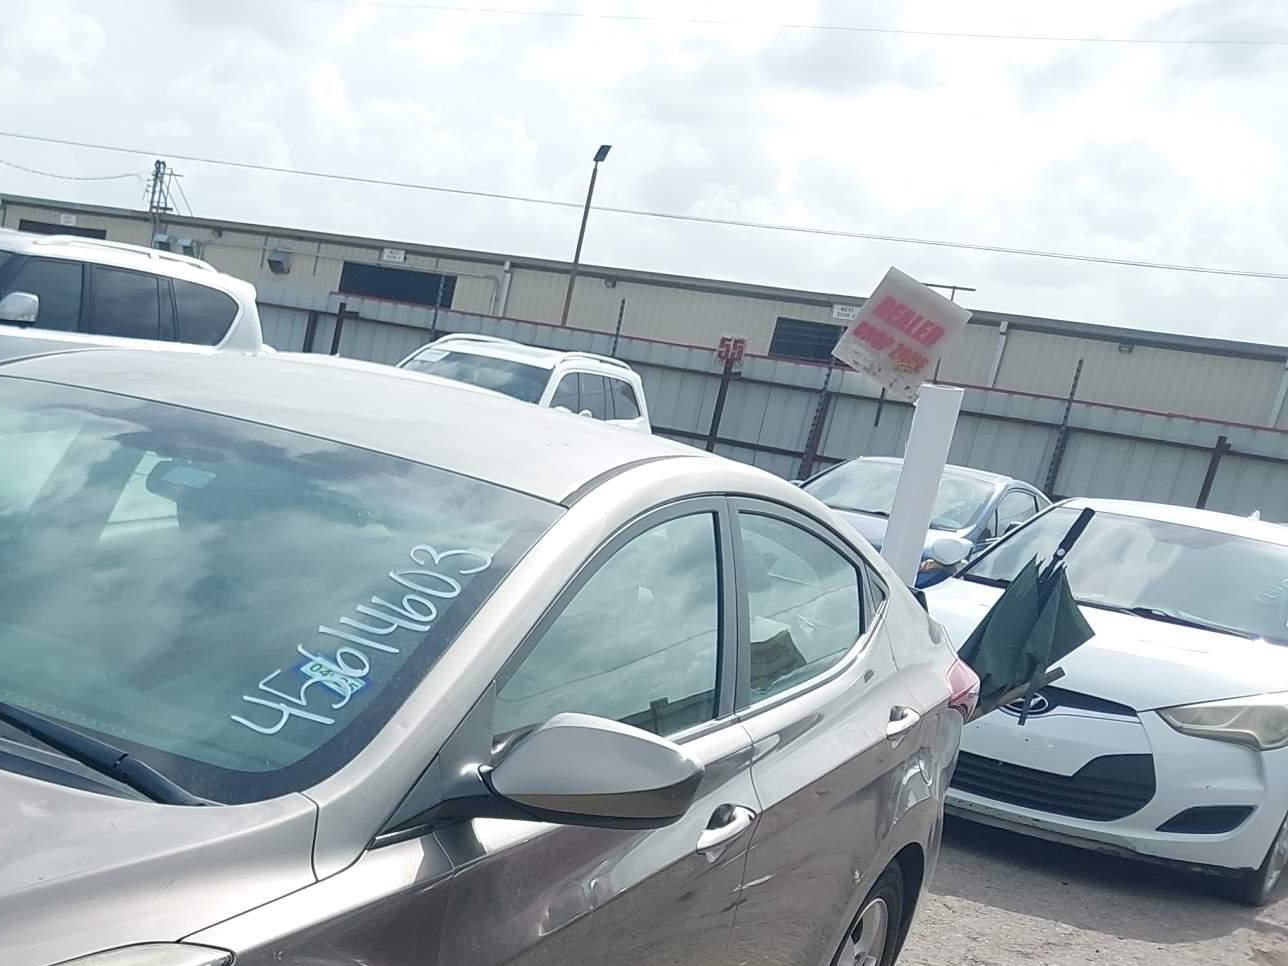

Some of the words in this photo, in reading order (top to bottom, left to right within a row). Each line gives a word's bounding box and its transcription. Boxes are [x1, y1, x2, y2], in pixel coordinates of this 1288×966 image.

[718, 336, 746, 360] 55
[873, 296, 945, 348] DEALER
[230, 543, 494, 735] 45614603
